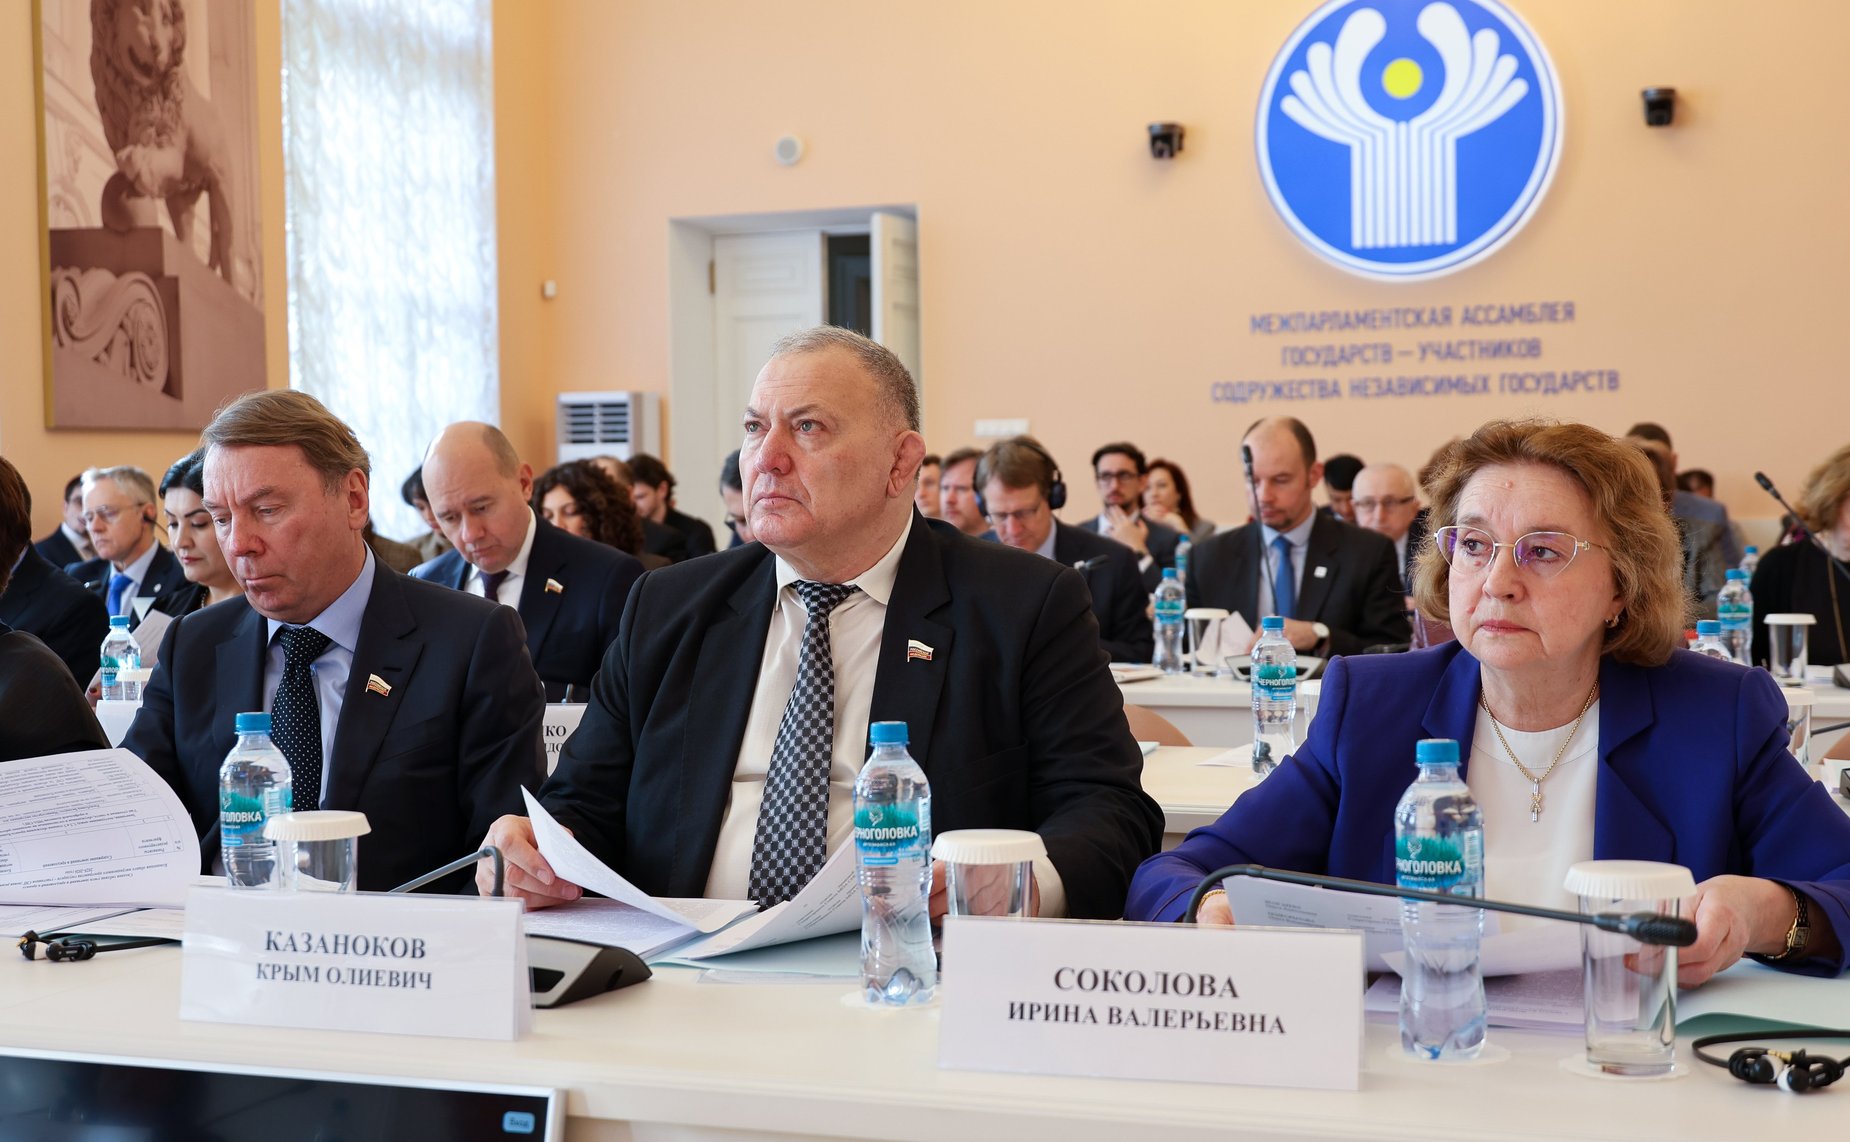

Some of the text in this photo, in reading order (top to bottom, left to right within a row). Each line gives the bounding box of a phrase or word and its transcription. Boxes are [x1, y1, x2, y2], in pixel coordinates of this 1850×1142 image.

[1250, 301, 1576, 335] МЕЖПАРЛАМЕНТСКАЯ АССАМБЛЕЯ
[1281, 341, 1393, 368] ГОСУДАРСТВ
[1418, 337, 1542, 363] УЧАСТНИКОВ
[1211, 369, 1620, 404] СОДРУЖЕСТВА НЕЗАВИСИМЫХ ГОСУДАРСТВ
[545, 725, 567, 737] КО
[265, 930, 427, 959] КАЗАНОКОВ
[256, 962, 433, 990] КРЫМ ОЛИЕВИЧ
[1054, 966, 1240, 999] СОКОЛОВА
[1007, 1001, 1287, 1035] ИРИНА ВАЛЕРЬЕВНА
